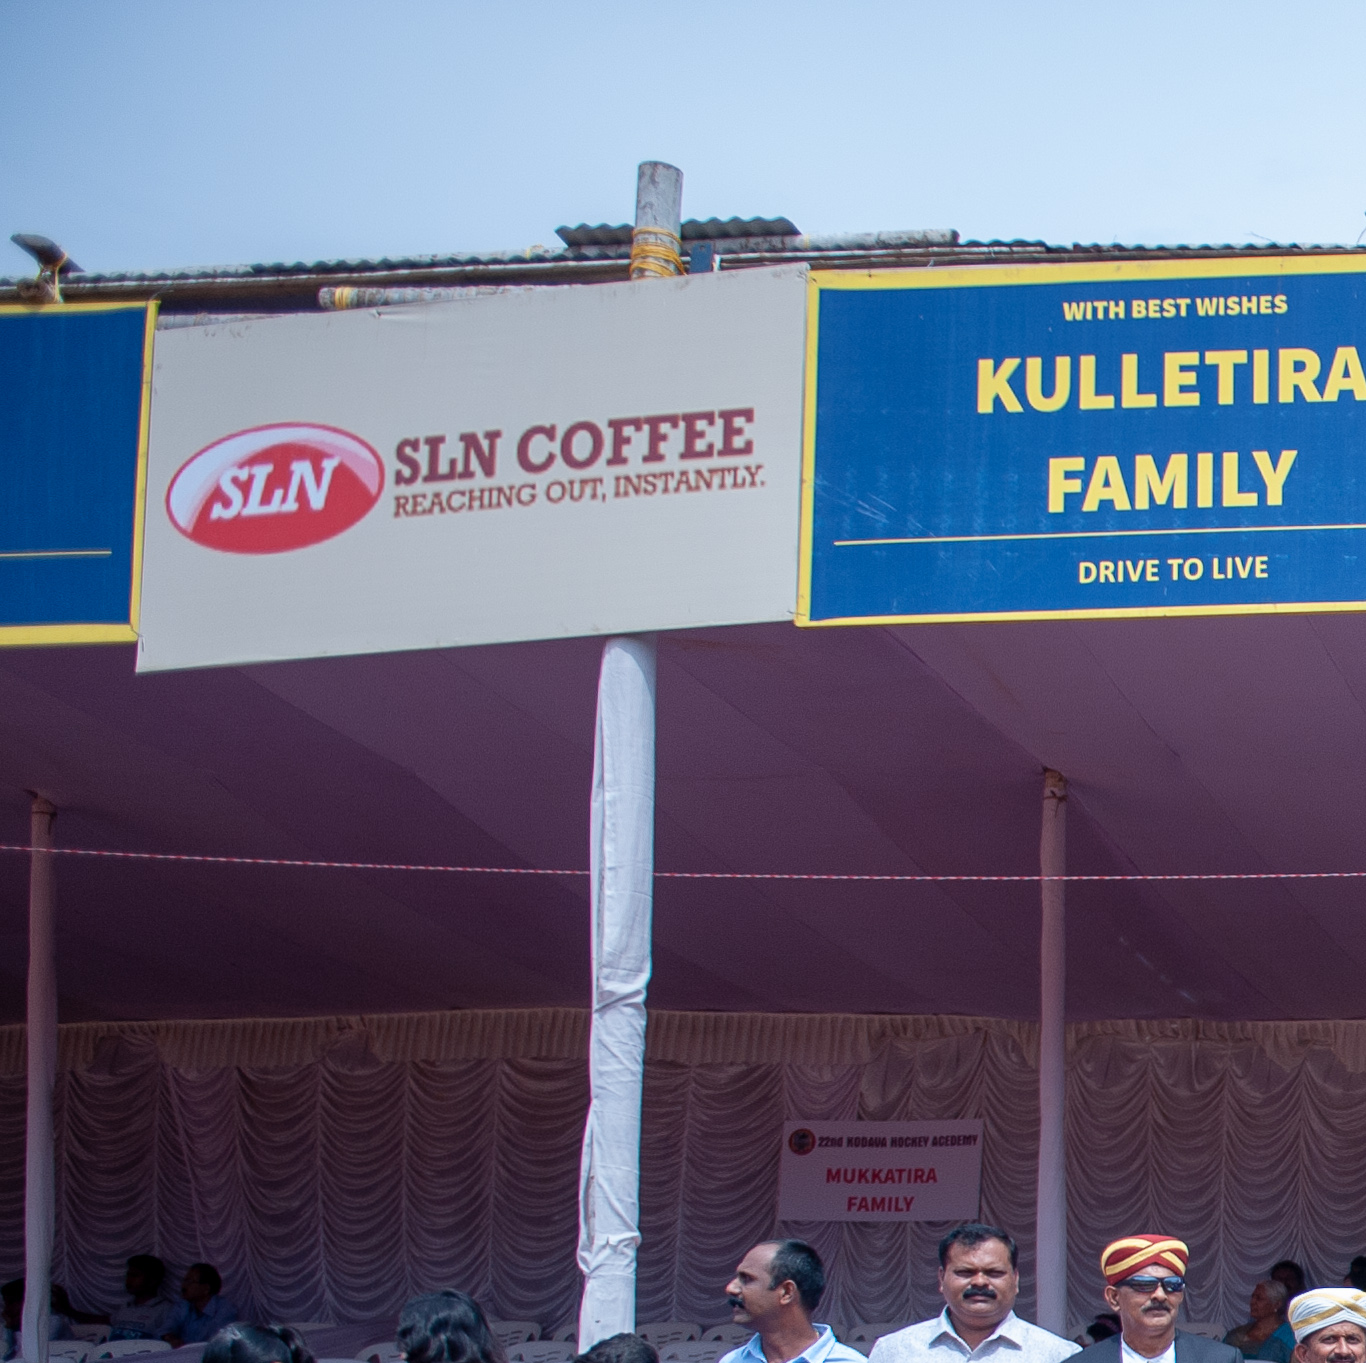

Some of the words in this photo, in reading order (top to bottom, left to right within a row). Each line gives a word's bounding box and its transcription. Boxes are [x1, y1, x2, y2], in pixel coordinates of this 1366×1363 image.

[1063, 299, 1125, 321] WITH
[1132, 297, 1190, 319] BEST
[1196, 294, 1288, 317] WISHES
[394, 429, 502, 487] SLN
[516, 407, 755, 475] COFFEE
[209, 454, 342, 521] SLN
[393, 483, 538, 519] REACHING
[545, 477, 607, 503] OUT,
[614, 464, 766, 498] INSTANTLY.
[1047, 449, 1299, 514] FAMILY
[1078, 559, 1160, 584] DRIVE
[1167, 557, 1204, 581] TO
[1212, 556, 1269, 579] LIVE
[818, 1136, 844, 1148] 22nd
[890, 1136, 930, 1148] HOCKEY
[931, 1134, 979, 1148] ACEDEMY
[825, 1167, 938, 1184] MUKKATIRA
[846, 1196, 916, 1213] FAMILY
